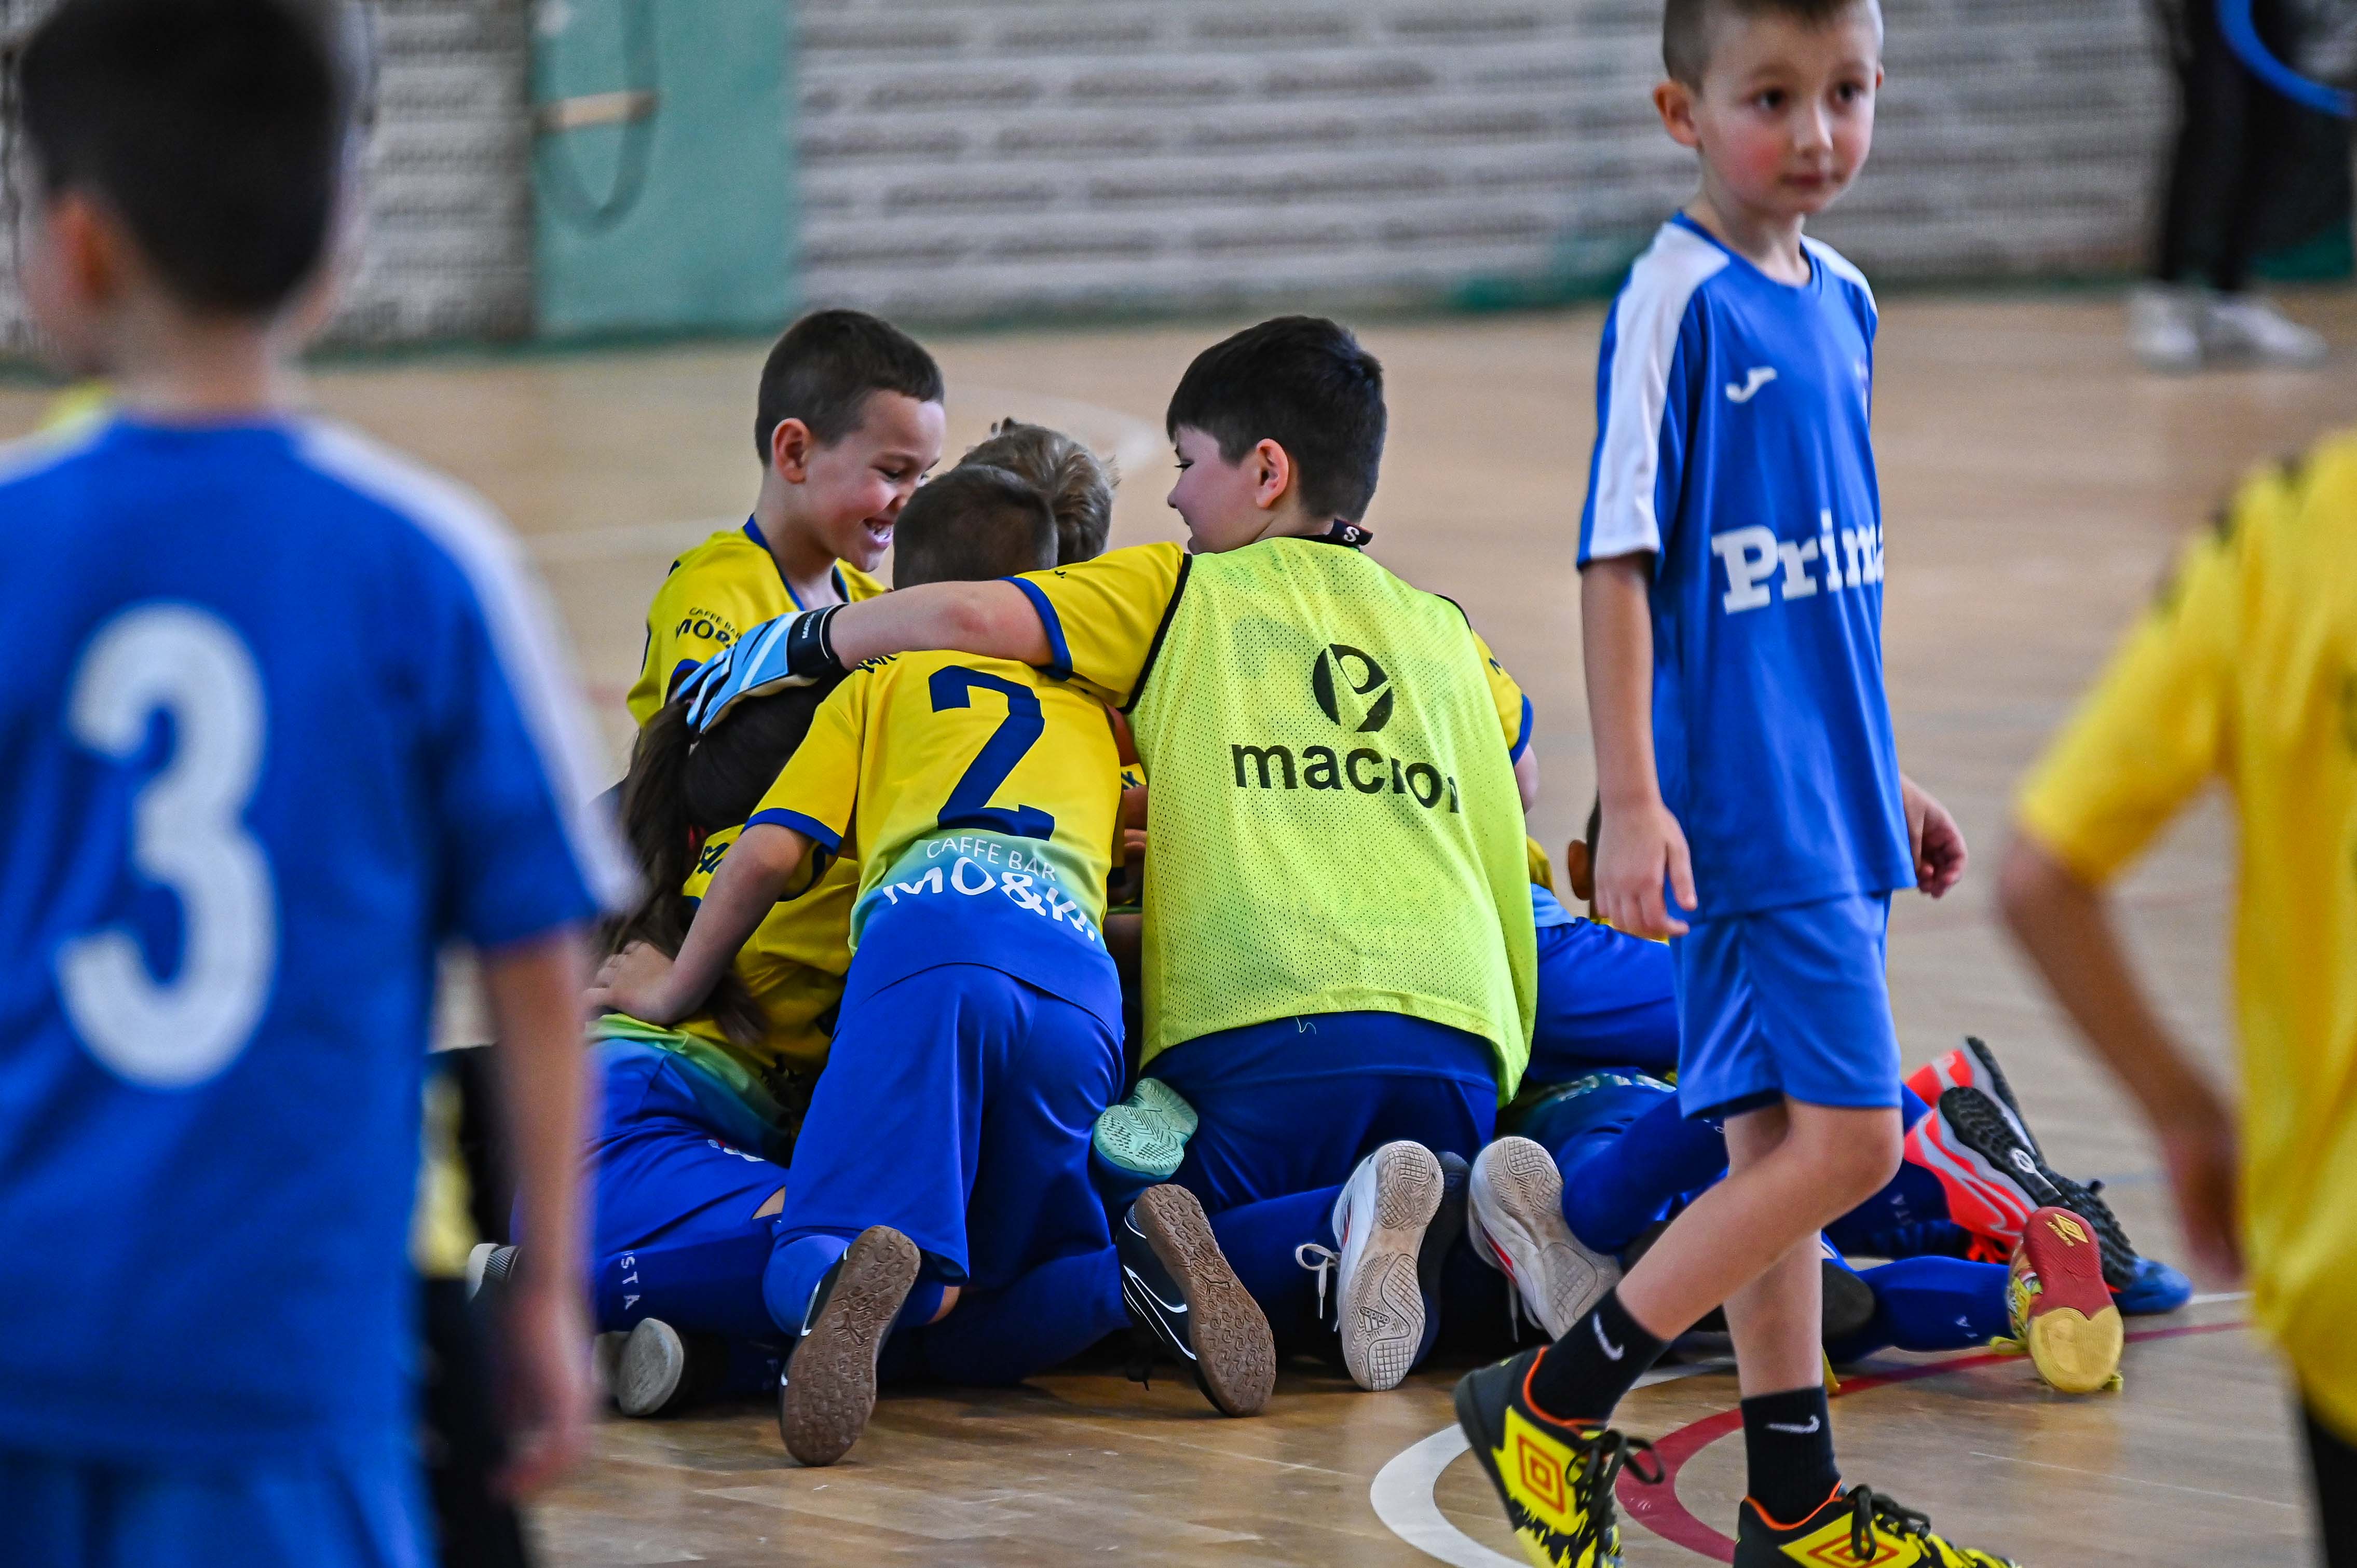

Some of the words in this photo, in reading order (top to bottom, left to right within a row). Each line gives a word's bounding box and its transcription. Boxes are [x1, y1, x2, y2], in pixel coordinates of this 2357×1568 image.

[928, 665, 1055, 842] 2
[55, 598, 281, 1088] 3
[927, 836, 1002, 865] CAFFE
[1008, 850, 1056, 882] BAR
